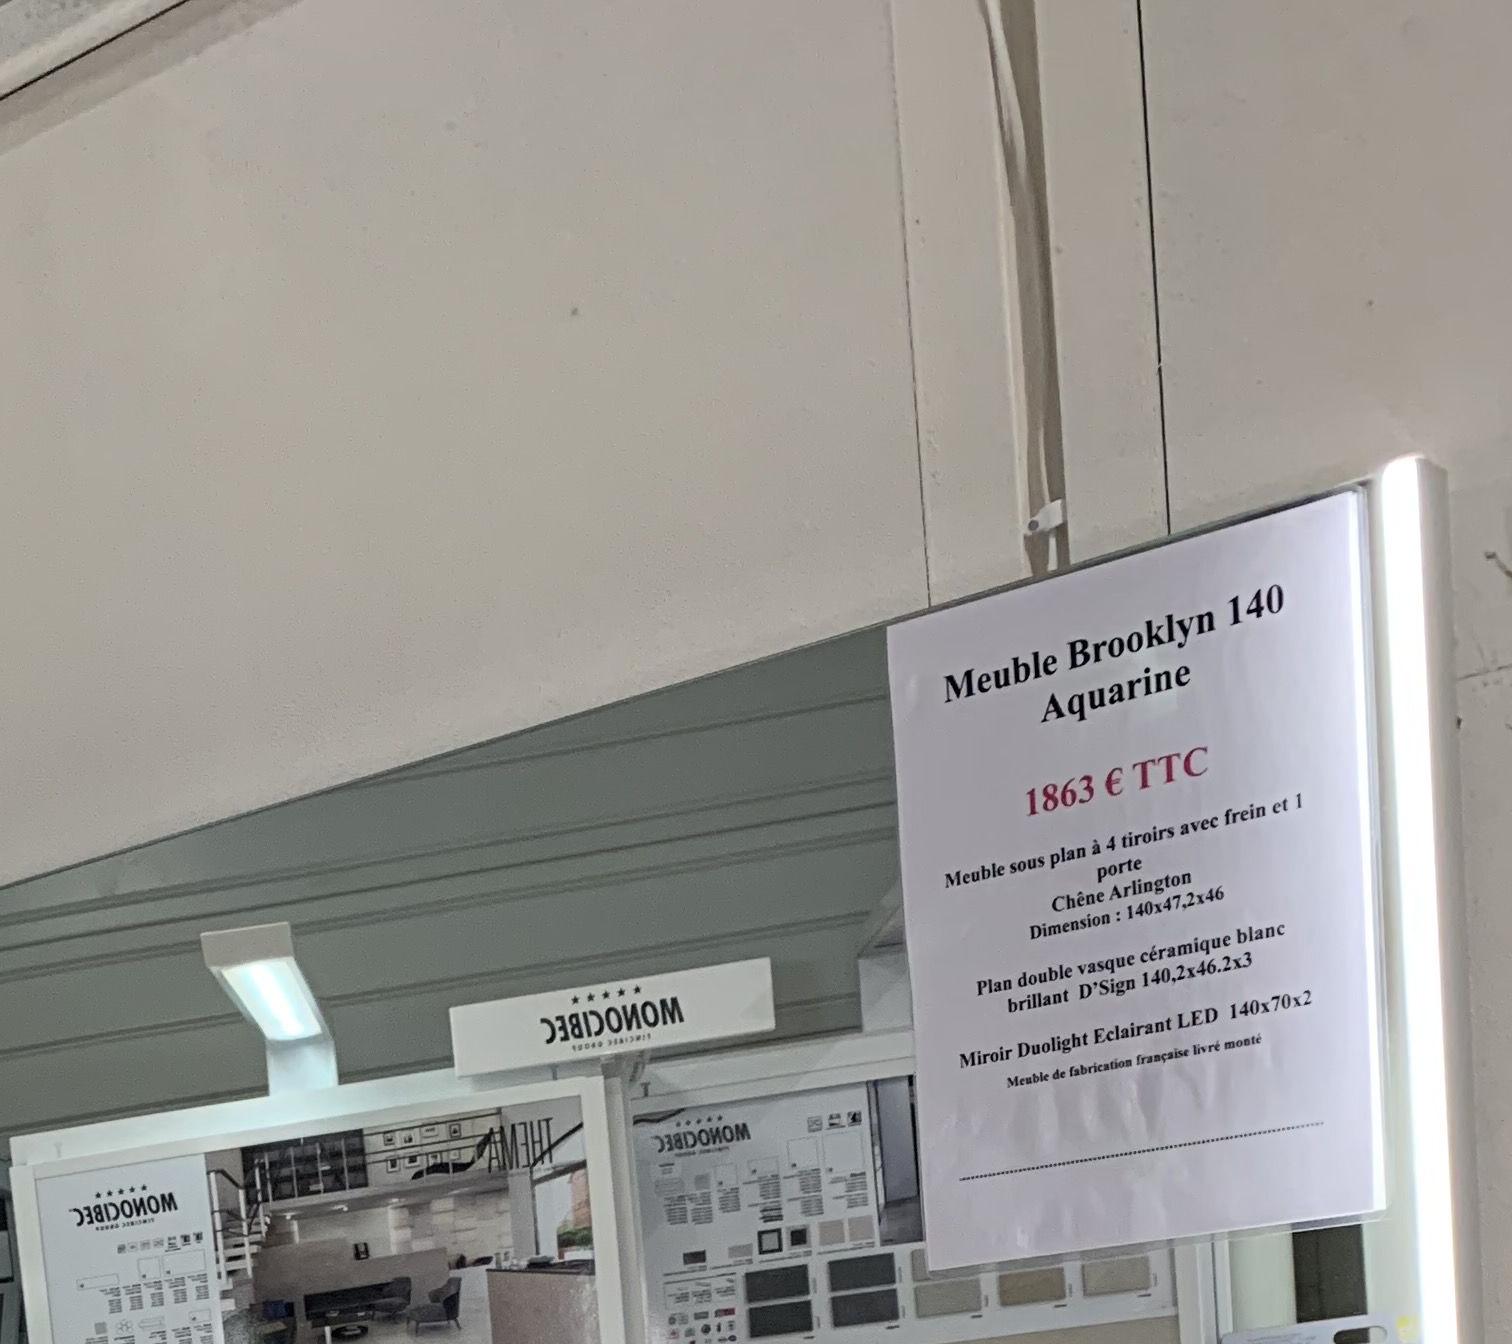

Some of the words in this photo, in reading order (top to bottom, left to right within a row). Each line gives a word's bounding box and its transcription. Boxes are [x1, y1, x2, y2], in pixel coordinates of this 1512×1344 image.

[944, 652, 1058, 703] Meuble
[1067, 611, 1215, 669] Brooklyn
[1228, 584, 1284, 626] 140
[1040, 665, 1191, 723] Aquarine
[1026, 775, 1094, 816] 1863
[1105, 767, 1123, 796] €
[1132, 747, 1208, 790] TTC
[944, 862, 1005, 888] Meuble
[1010, 856, 1045, 875] sous
[1050, 845, 1086, 868] plan
[1092, 840, 1101, 855] à
[1106, 836, 1116, 851] 4
[1121, 826, 1175, 849] tiroirs
[1180, 816, 1219, 836] avec
[1224, 804, 1267, 826] frein
[1272, 799, 1289, 815] et
[1295, 793, 1303, 809] 1
[1097, 857, 1142, 882] porte
[1030, 911, 1110, 940] Dimension
[1127, 886, 1225, 921] 140x47,2x46
[1052, 888, 1105, 912] Chêne
[1109, 871, 1192, 902] Arlington
[976, 978, 1012, 996] Plan
[1017, 965, 1073, 988] double
[1077, 954, 1135, 976] vasque
[1140, 934, 1231, 964] céramique
[1237, 923, 1286, 945] blanc
[1008, 989, 1069, 1014] brillant
[1141, 951, 1253, 988] 140,2x46.2x3
[960, 1048, 1013, 1069] Miroir
[1017, 1032, 1089, 1059] Duolight
[1093, 1016, 1172, 1045] Eclairant
[1177, 1007, 1218, 1030] LED
[1229, 989, 1313, 1020] 140x70x2
[1006, 1071, 1050, 1089] Meuble
[1052, 1068, 1066, 1080] de
[1069, 1056, 1133, 1078] fabrication
[1136, 1048, 1189, 1066] française
[1192, 1040, 1221, 1057] livré
[1224, 1033, 1263, 1051] monté
